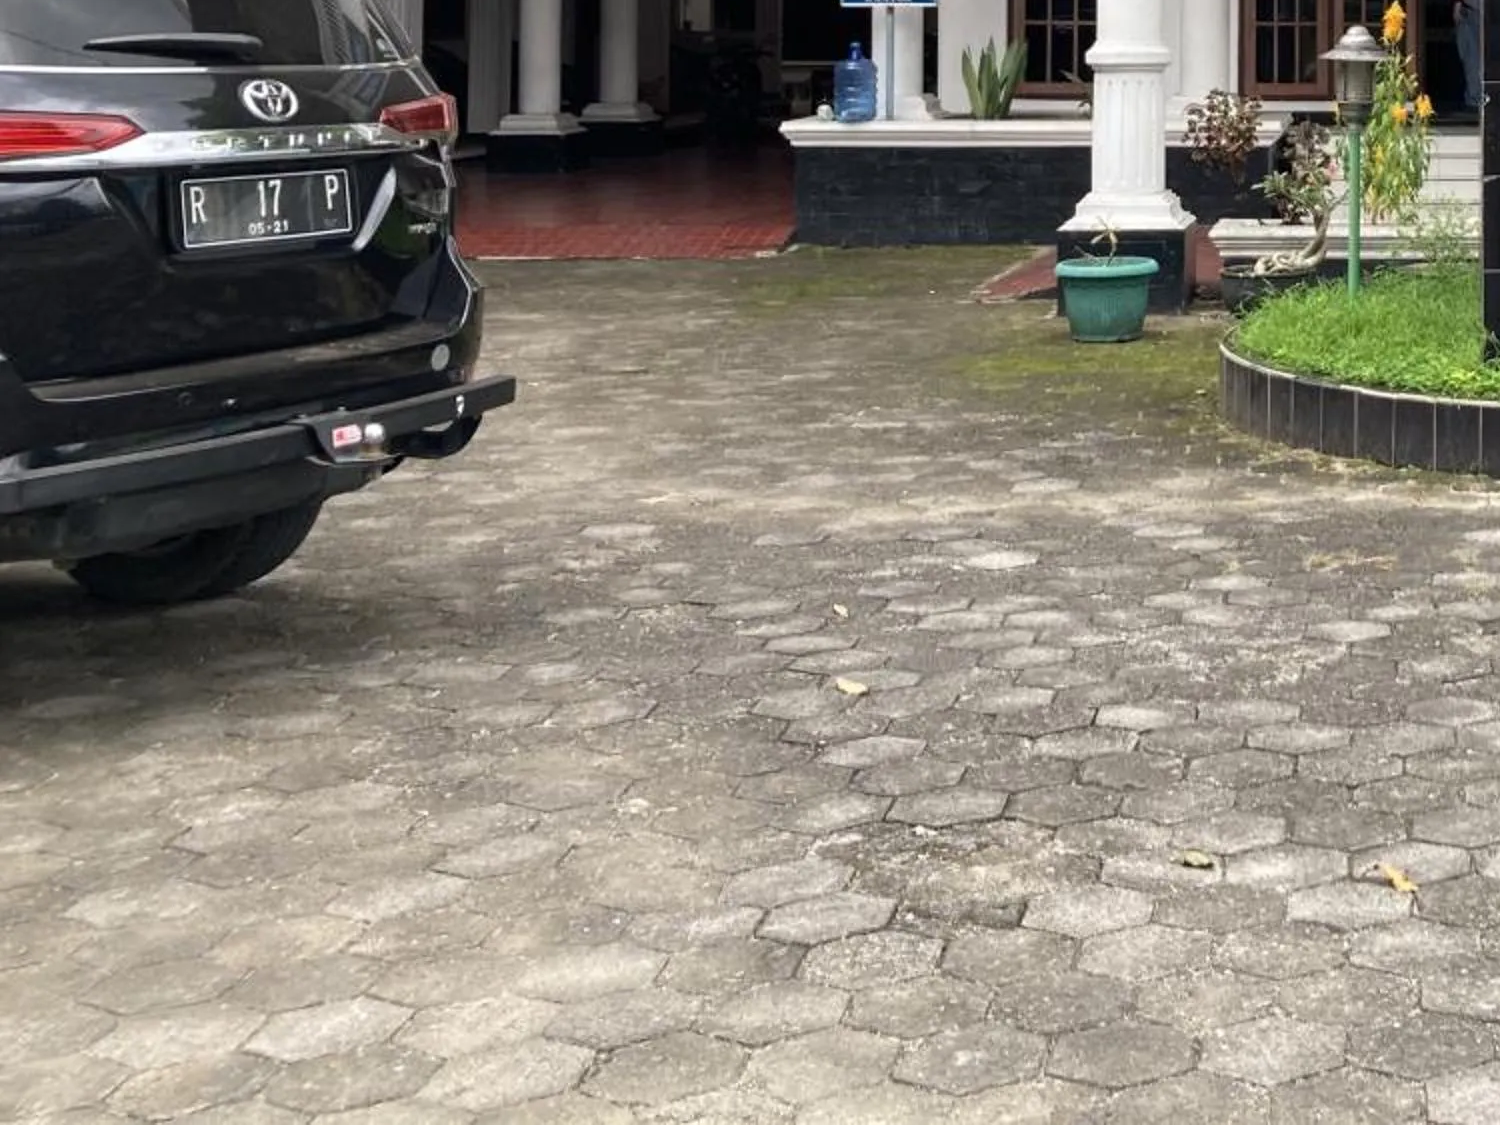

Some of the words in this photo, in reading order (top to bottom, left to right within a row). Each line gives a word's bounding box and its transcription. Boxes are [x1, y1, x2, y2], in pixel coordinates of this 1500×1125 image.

[189, 186, 207, 224] R
[257, 179, 282, 218] 17
[324, 174, 339, 211] P
